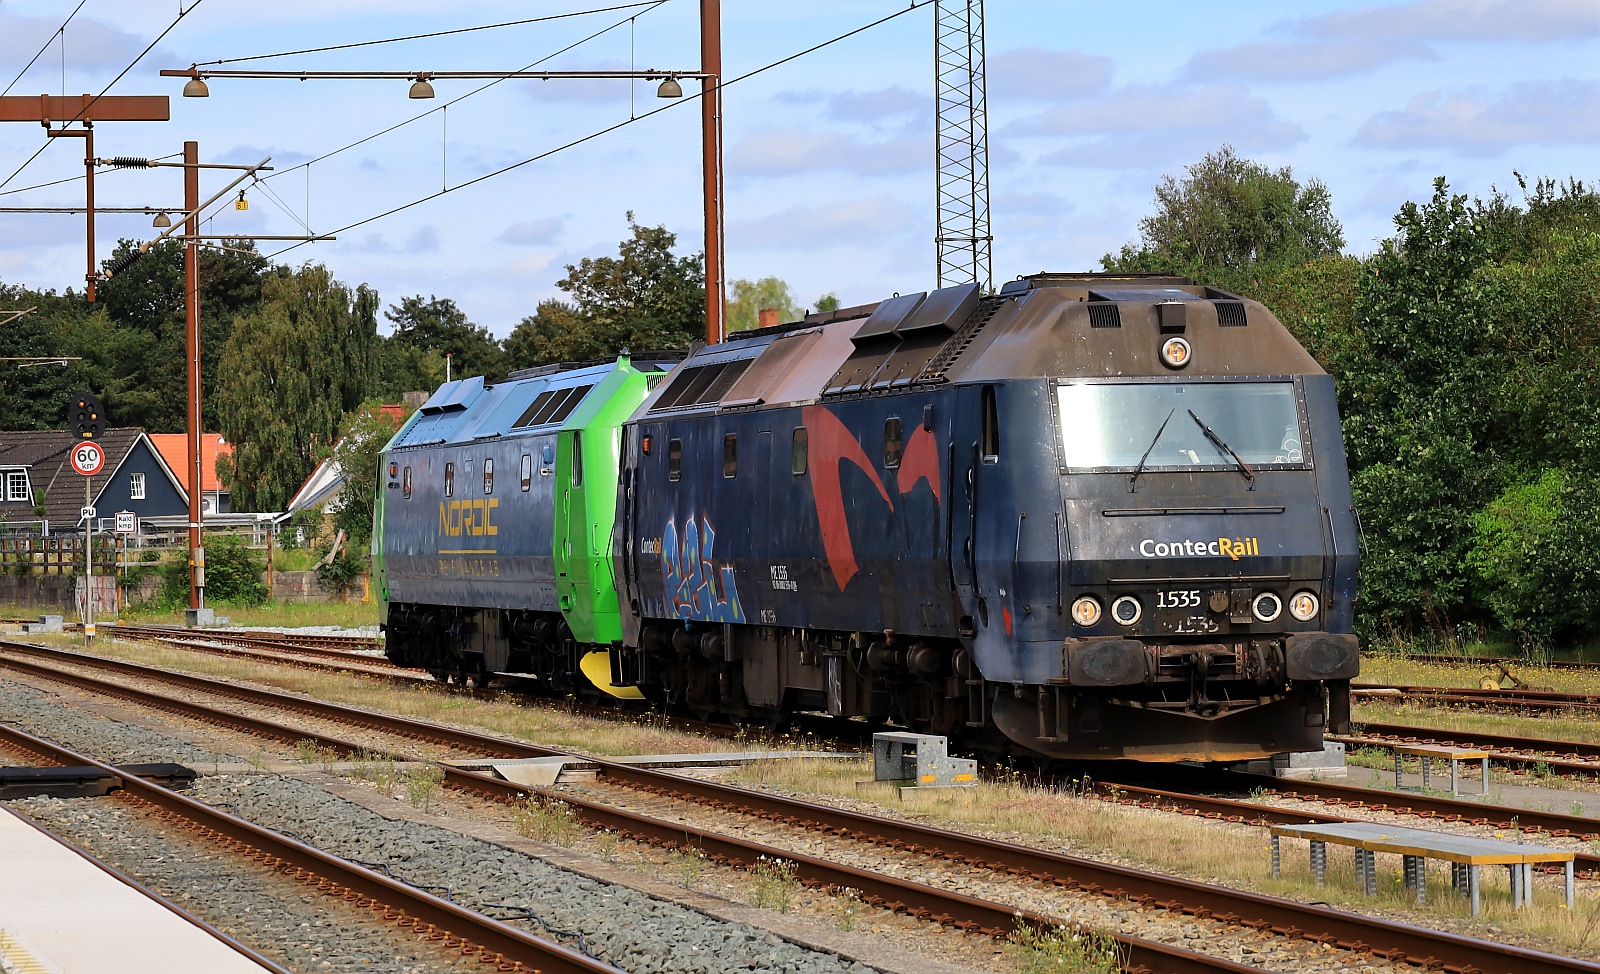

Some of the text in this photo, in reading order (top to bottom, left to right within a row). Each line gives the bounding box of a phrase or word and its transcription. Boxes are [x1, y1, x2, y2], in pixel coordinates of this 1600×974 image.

[77, 449, 98, 462] 60
[82, 509, 94, 517] PU
[438, 498, 499, 537] NORDIC
[1139, 537, 1259, 561] ContecRail
[1156, 590, 1201, 608] 1535
